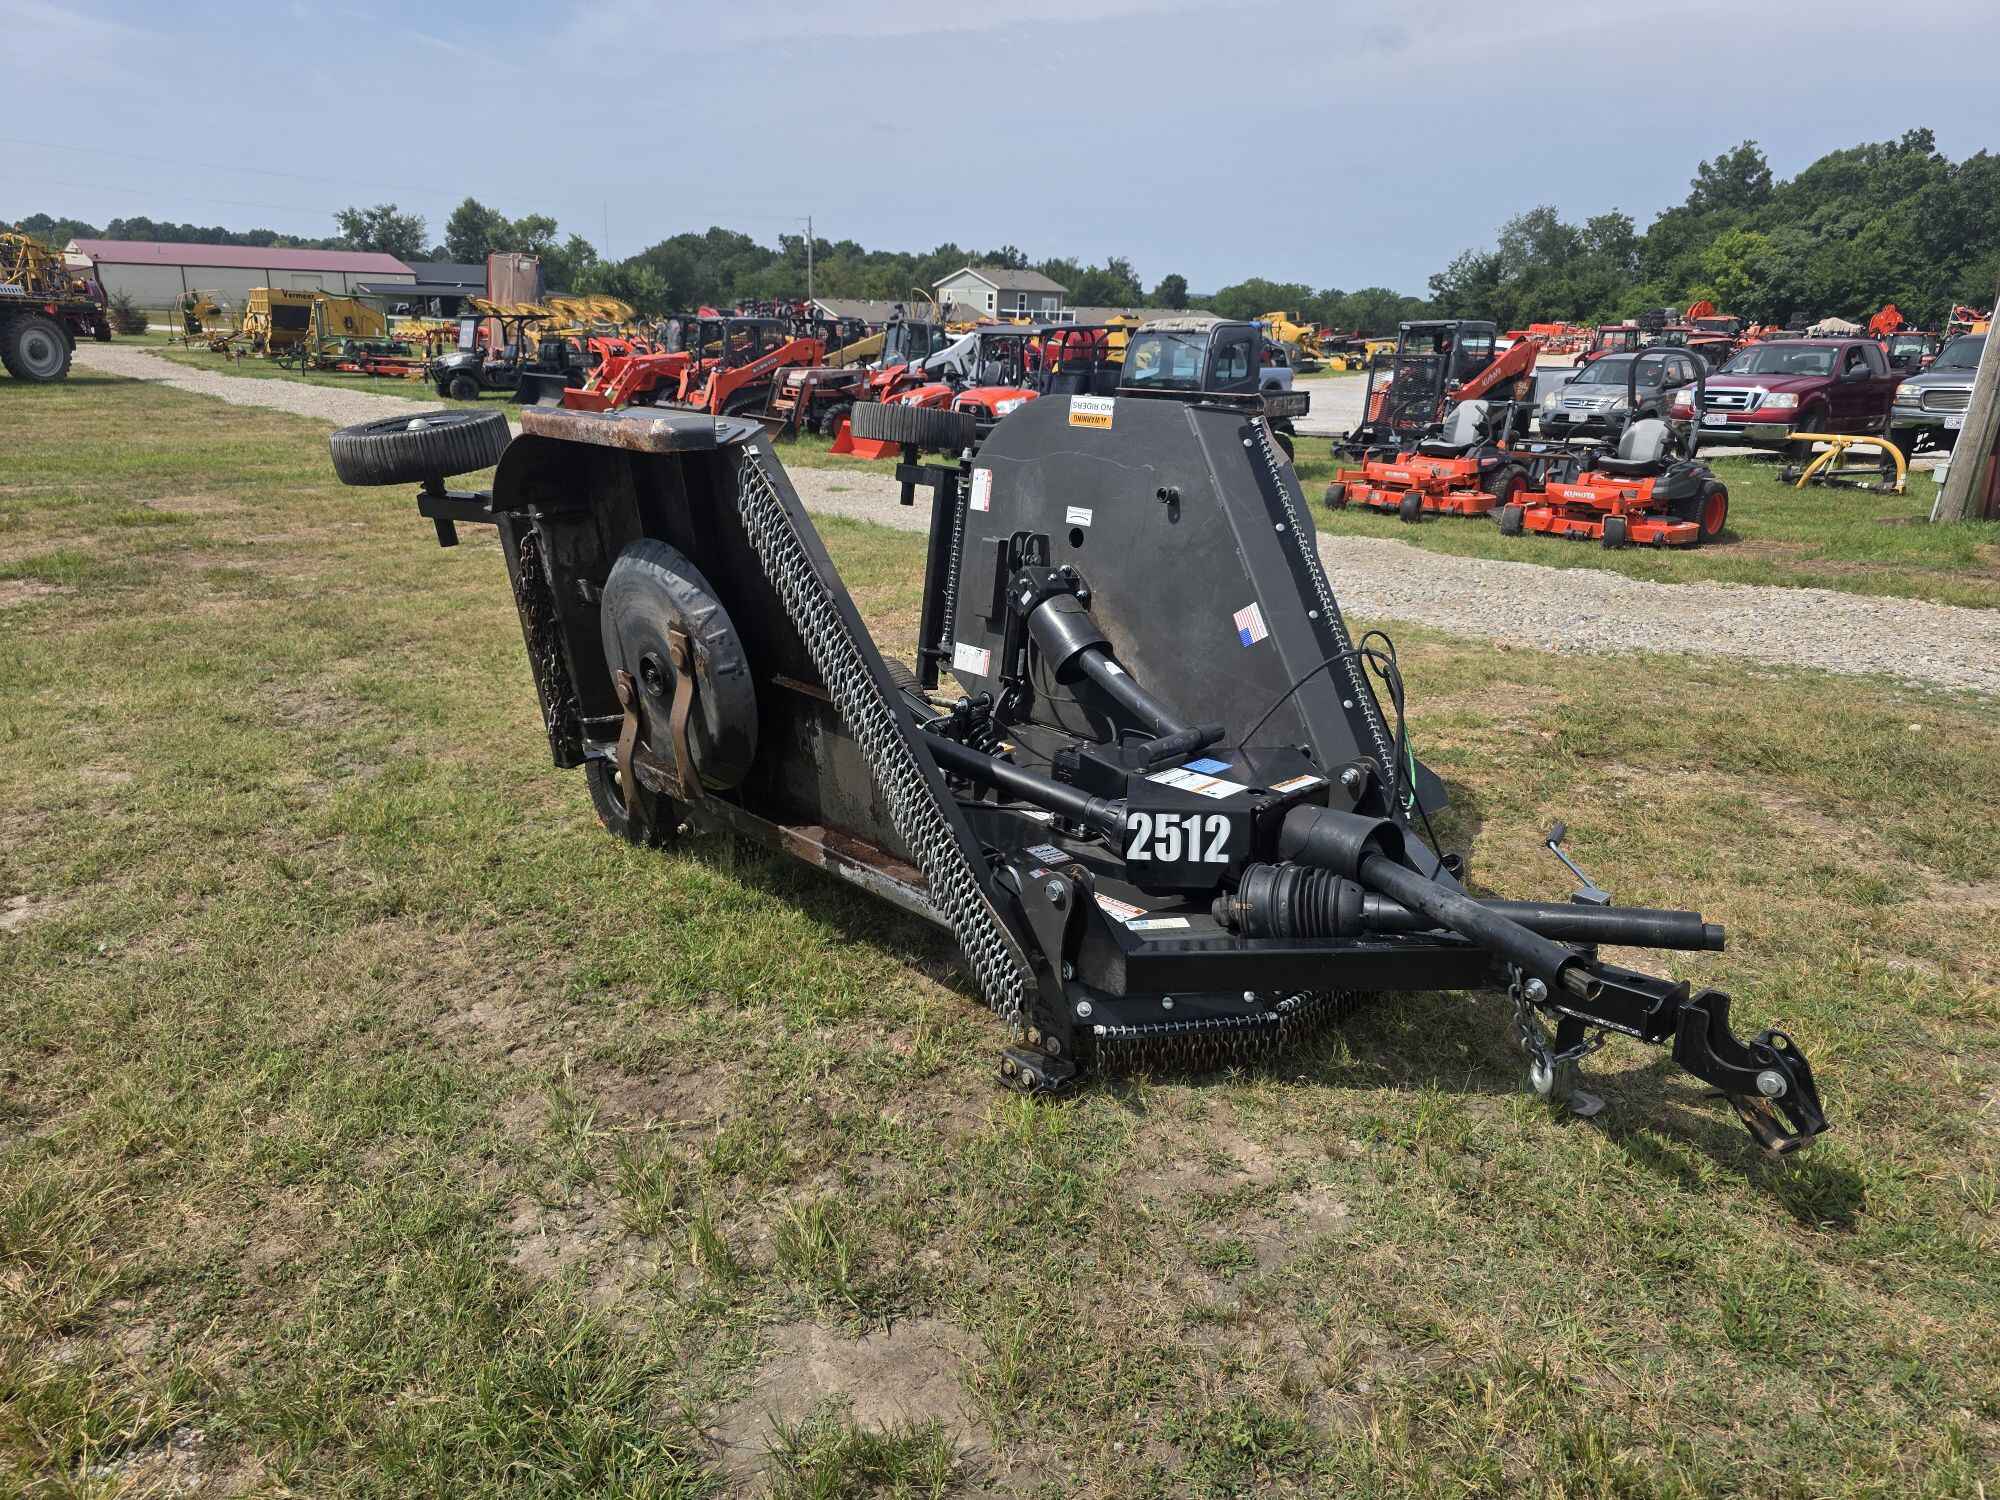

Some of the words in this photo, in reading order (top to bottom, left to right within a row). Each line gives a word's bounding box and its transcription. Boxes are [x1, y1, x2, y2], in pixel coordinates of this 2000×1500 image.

[281, 290, 315, 299] Vermeer
[1072, 401, 1099, 410] RIDERS
[1100, 403, 1112, 411] NO
[1073, 414, 1101, 424] WARNING
[1126, 812, 1231, 863] 2512
